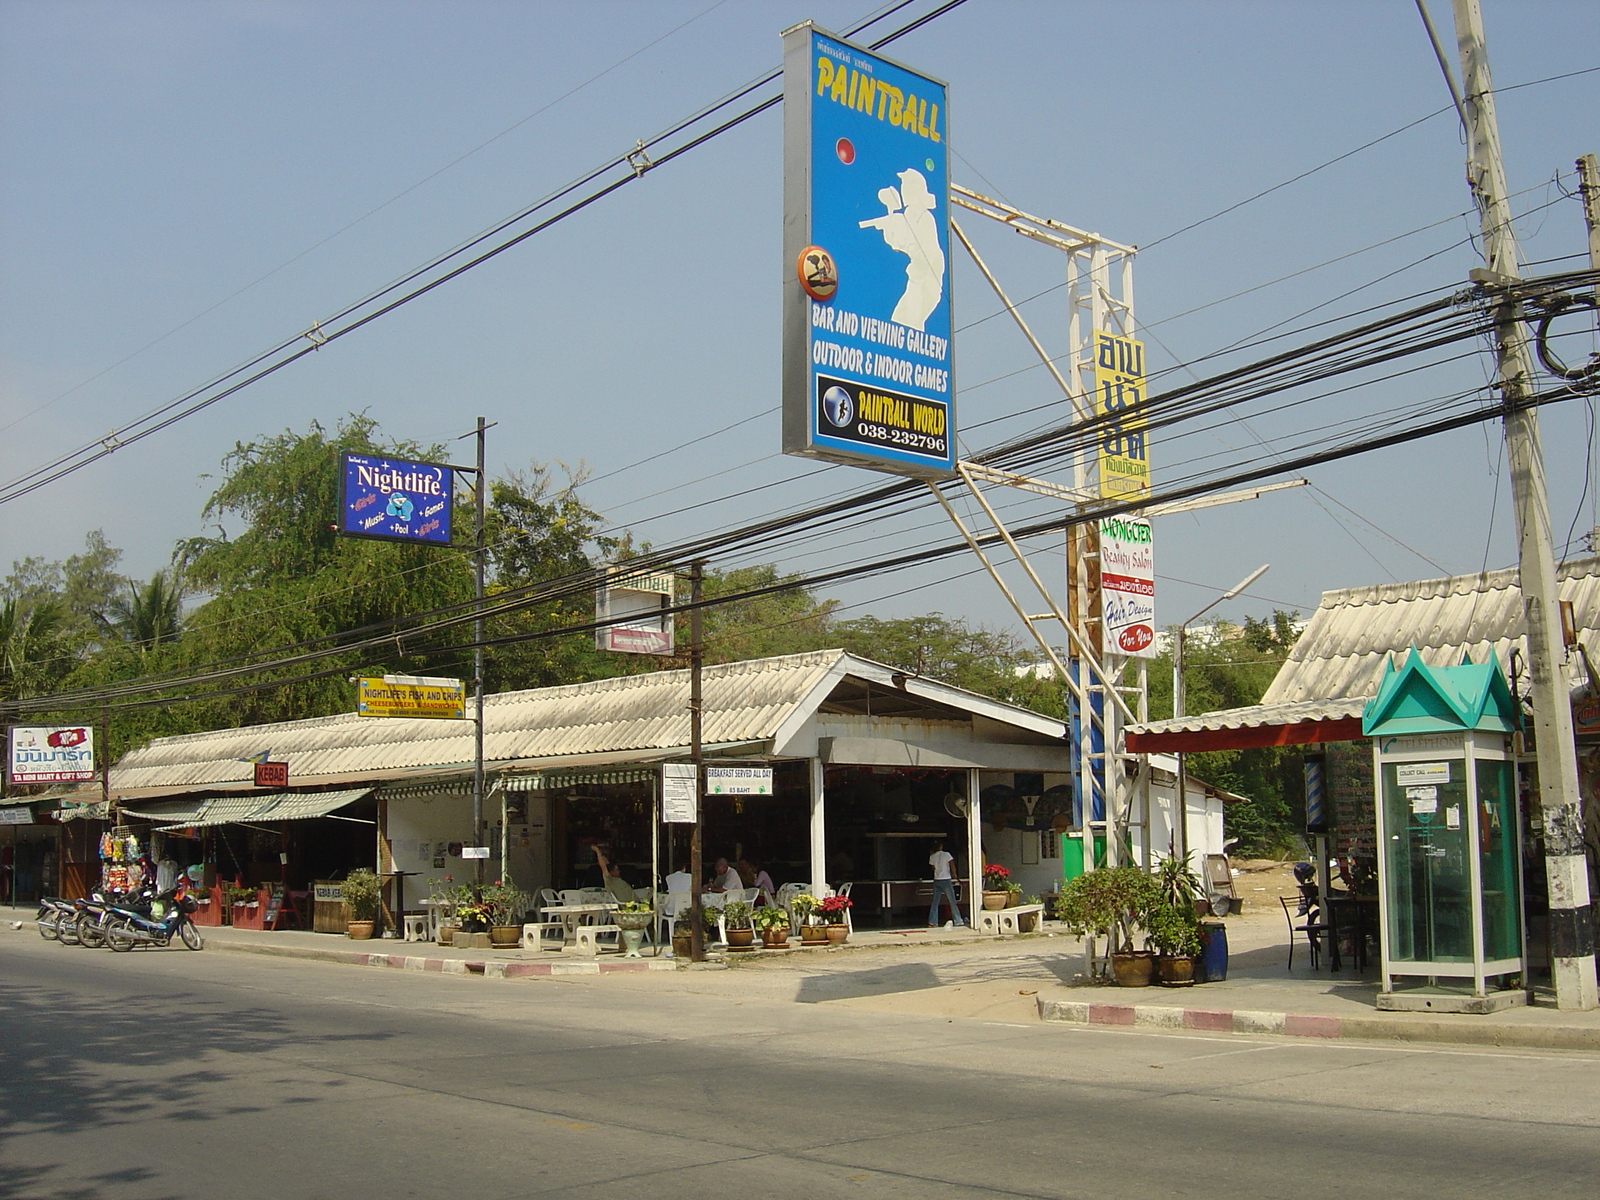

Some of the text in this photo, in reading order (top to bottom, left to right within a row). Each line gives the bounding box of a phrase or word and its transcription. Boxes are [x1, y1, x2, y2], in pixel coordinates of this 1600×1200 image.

[817, 57, 941, 142] PAINTBALL
[812, 303, 947, 361] BAR AND VIEWING GALLERY
[813, 340, 948, 393] OUTDOOR & INDOOR GAMES
[859, 391, 945, 436] PAINTBALL WORLD
[857, 423, 945, 451] 038-232796
[357, 465, 441, 496] Nightlife
[424, 501, 444, 518] Games
[364, 511, 385, 530] Music
[394, 523, 409, 535] Pool
[1103, 547, 1152, 570] Beauty Salon
[1106, 600, 1153, 626] Hair Design
[1121, 628, 1152, 647] For You
[364, 689, 462, 702] NIGHTLIFE'S FISH AND CHIPS
[366, 700, 415, 708] CHEESEBURGERS
[258, 767, 285, 781] KEBAB
[708, 768, 771, 778] BREAKFAST SERVED ALL DAY
